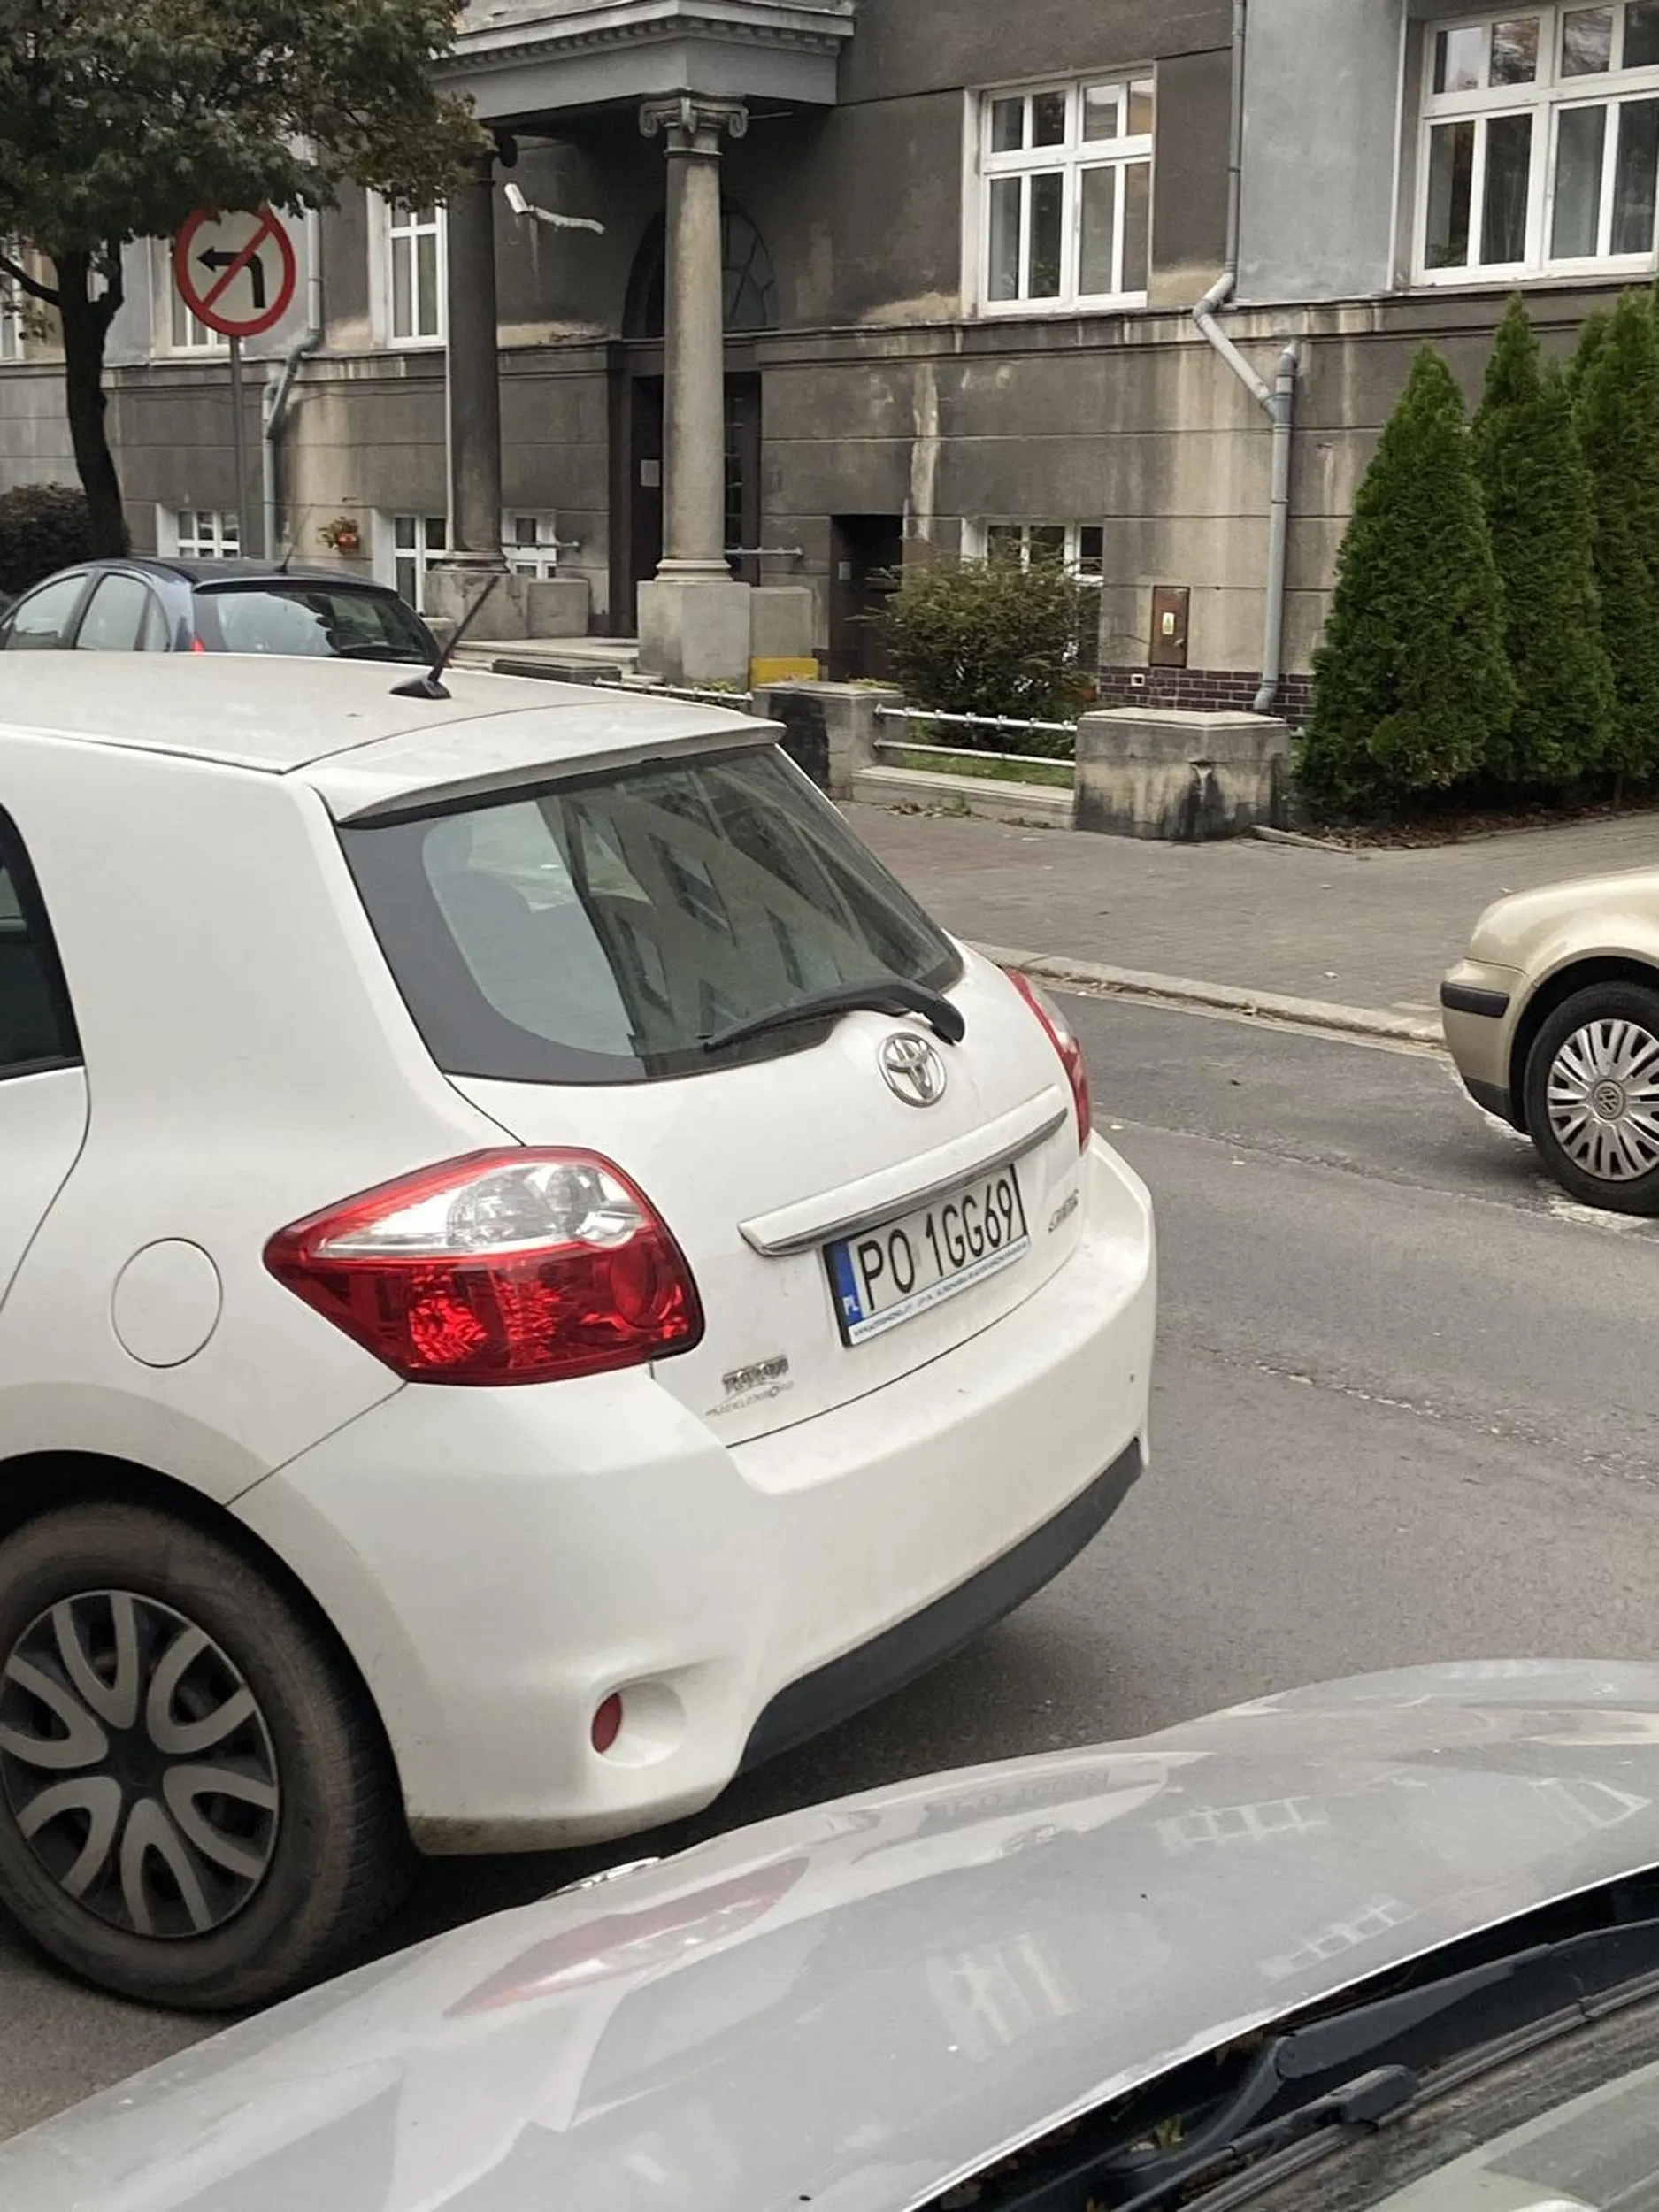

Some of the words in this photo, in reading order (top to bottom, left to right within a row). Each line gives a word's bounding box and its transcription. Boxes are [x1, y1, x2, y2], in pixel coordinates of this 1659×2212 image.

[857, 1228, 915, 1311] PO
[926, 1179, 1013, 1277] 1GG69
[842, 1294, 860, 1316] PL
